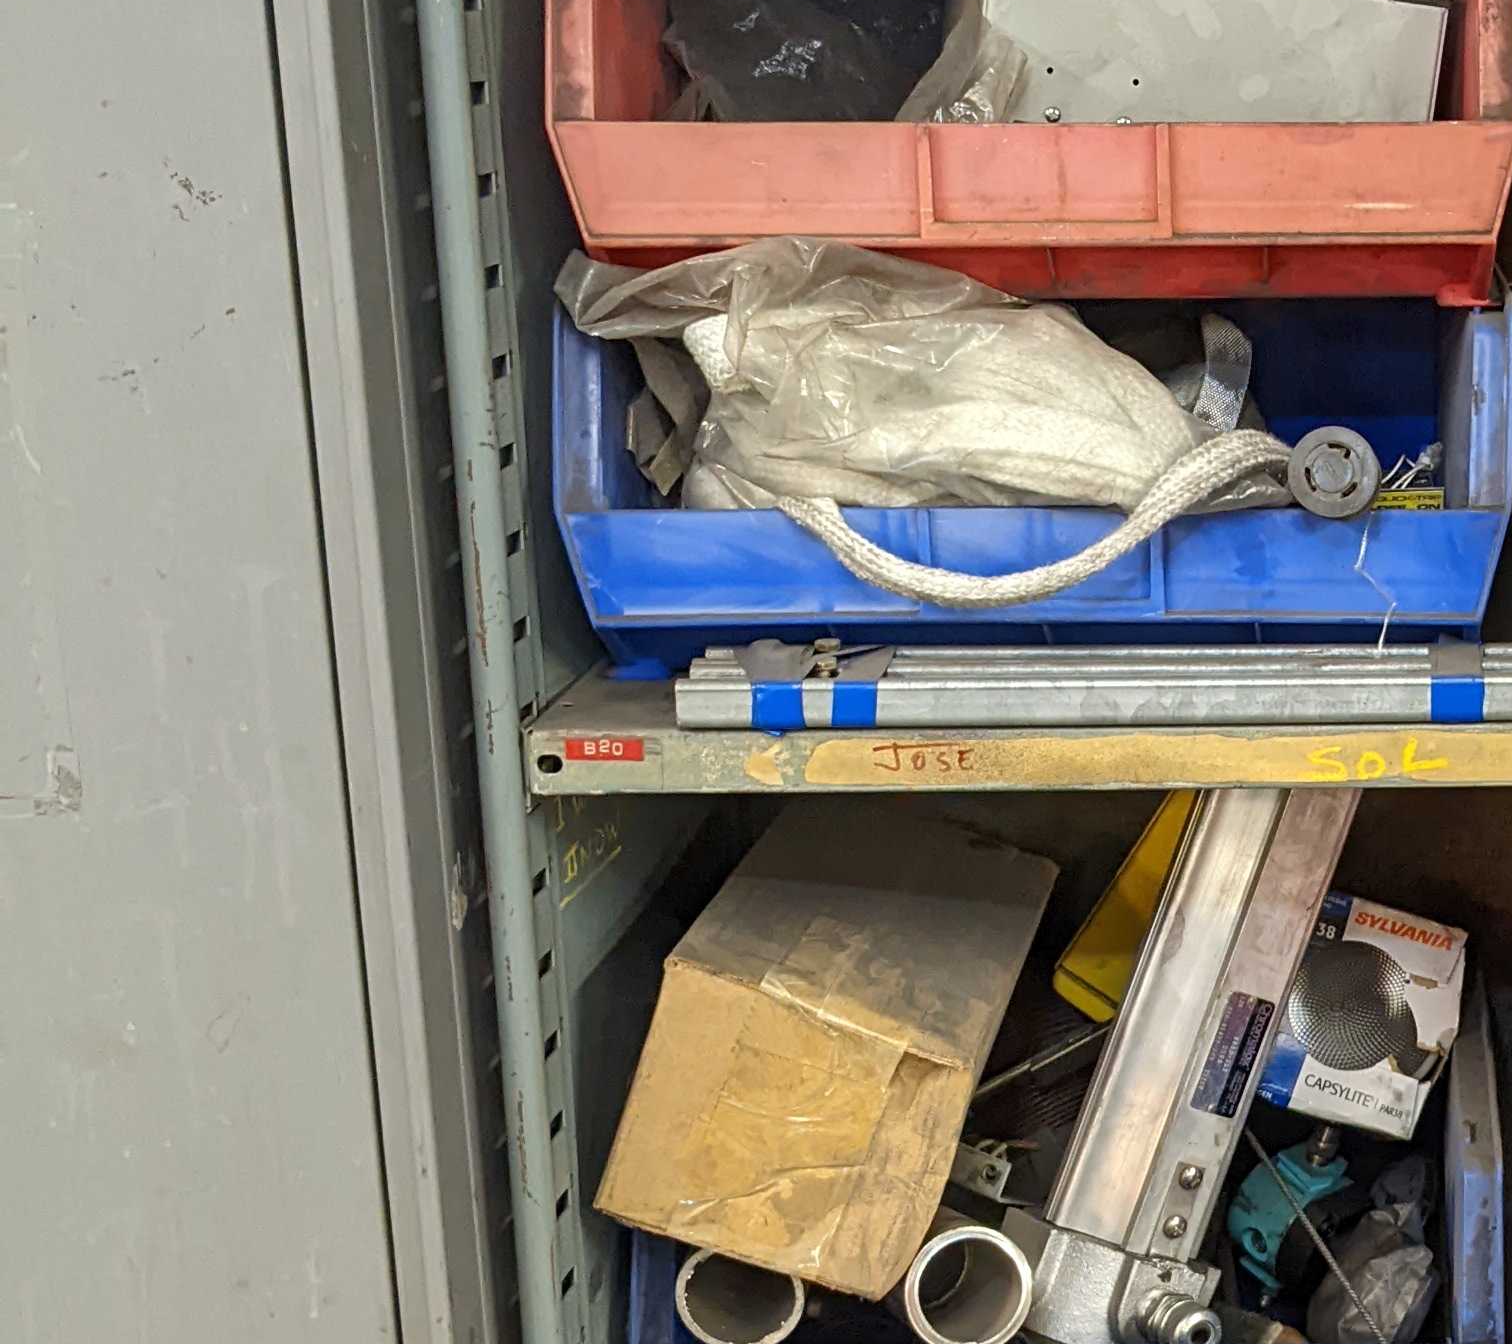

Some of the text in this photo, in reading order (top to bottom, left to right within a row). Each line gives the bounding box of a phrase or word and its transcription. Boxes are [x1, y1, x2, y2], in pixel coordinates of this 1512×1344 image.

[583, 739, 623, 757] B20
[872, 740, 977, 773] JOSE
[1306, 737, 1448, 782] SOL
[1354, 911, 1454, 951] SYLVANIA
[1304, 1073, 1373, 1108] CAPSYLITE
